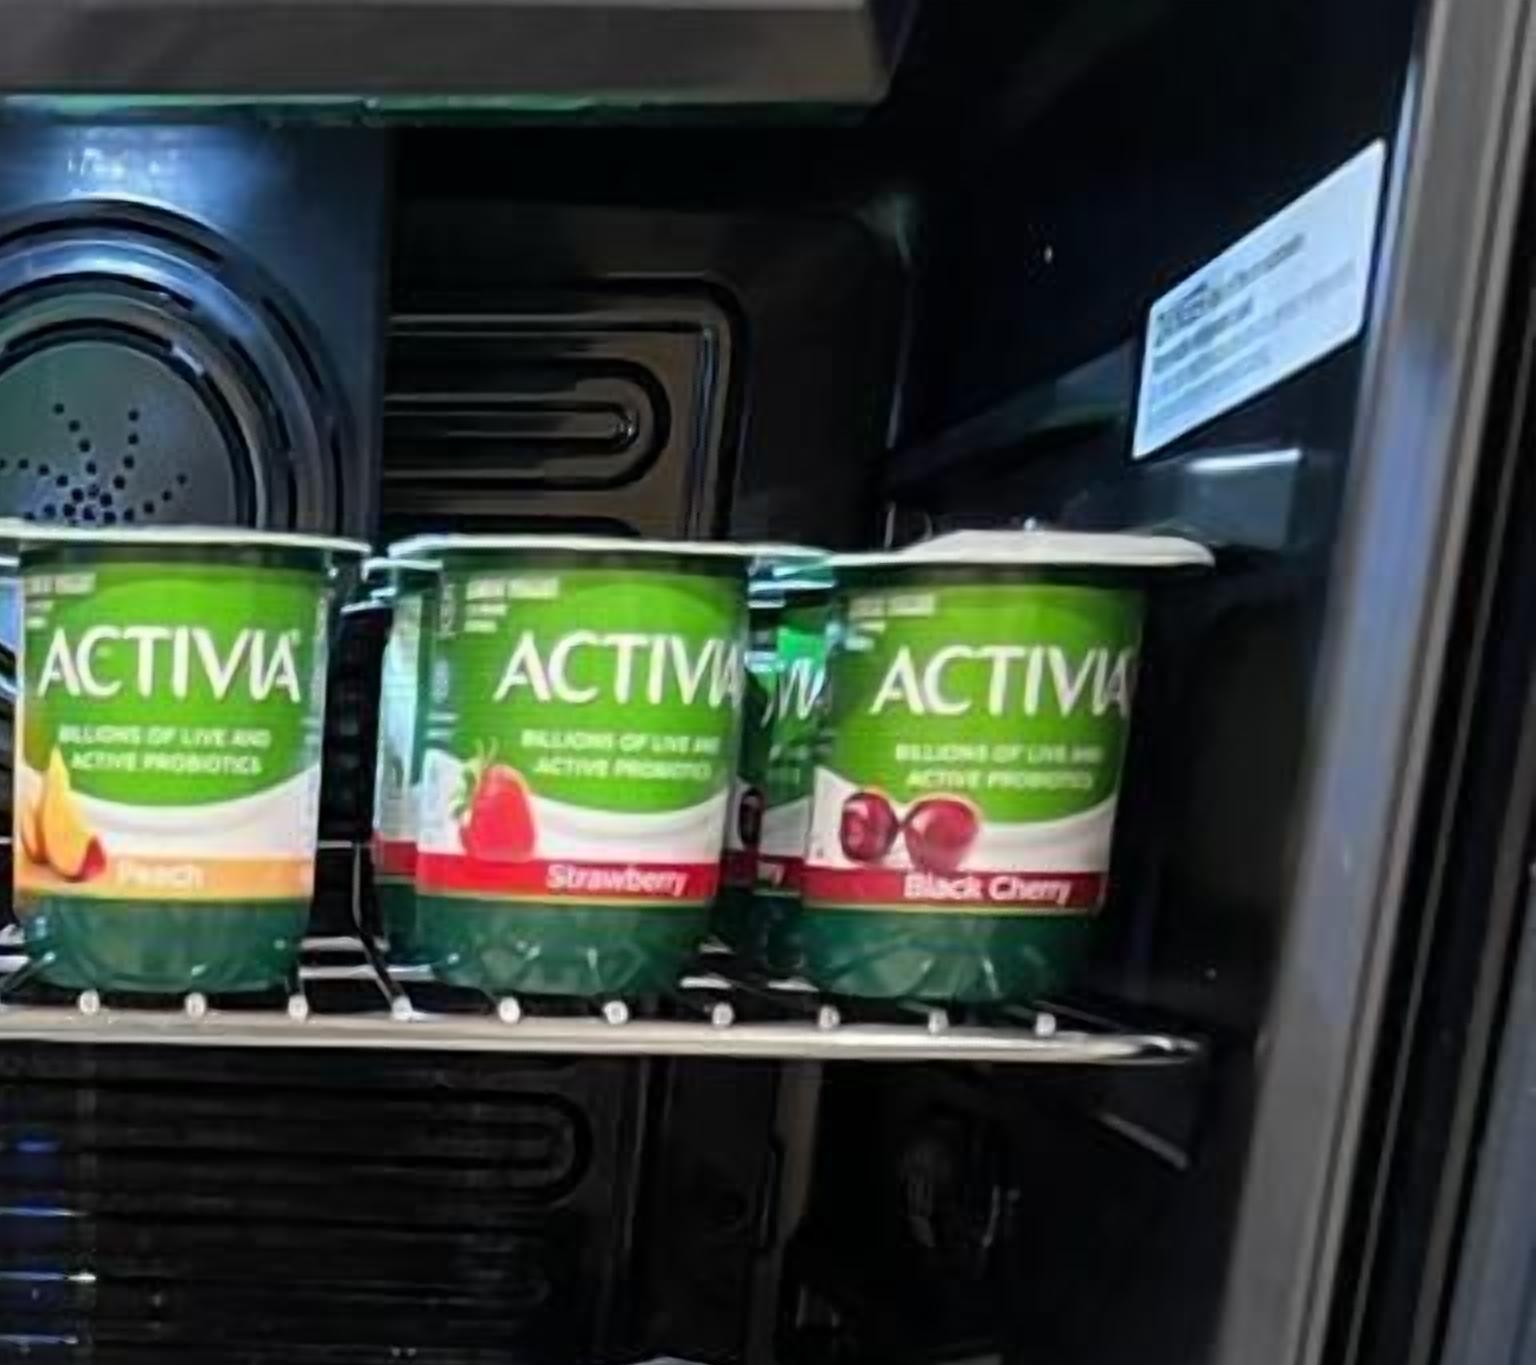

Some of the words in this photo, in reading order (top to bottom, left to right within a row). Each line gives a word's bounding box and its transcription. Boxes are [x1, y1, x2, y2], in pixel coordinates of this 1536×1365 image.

[37, 625, 302, 703] ACTIVIA
[870, 643, 1132, 719] ACTIVIA
[58, 725, 141, 745] BILLIONS
[146, 727, 176, 747] OF
[179, 728, 225, 747] LIVE
[72, 751, 137, 771] ACTIVE
[547, 863, 689, 897] Strawberry
[904, 871, 983, 900] Black
[989, 875, 1071, 905] Cherry
